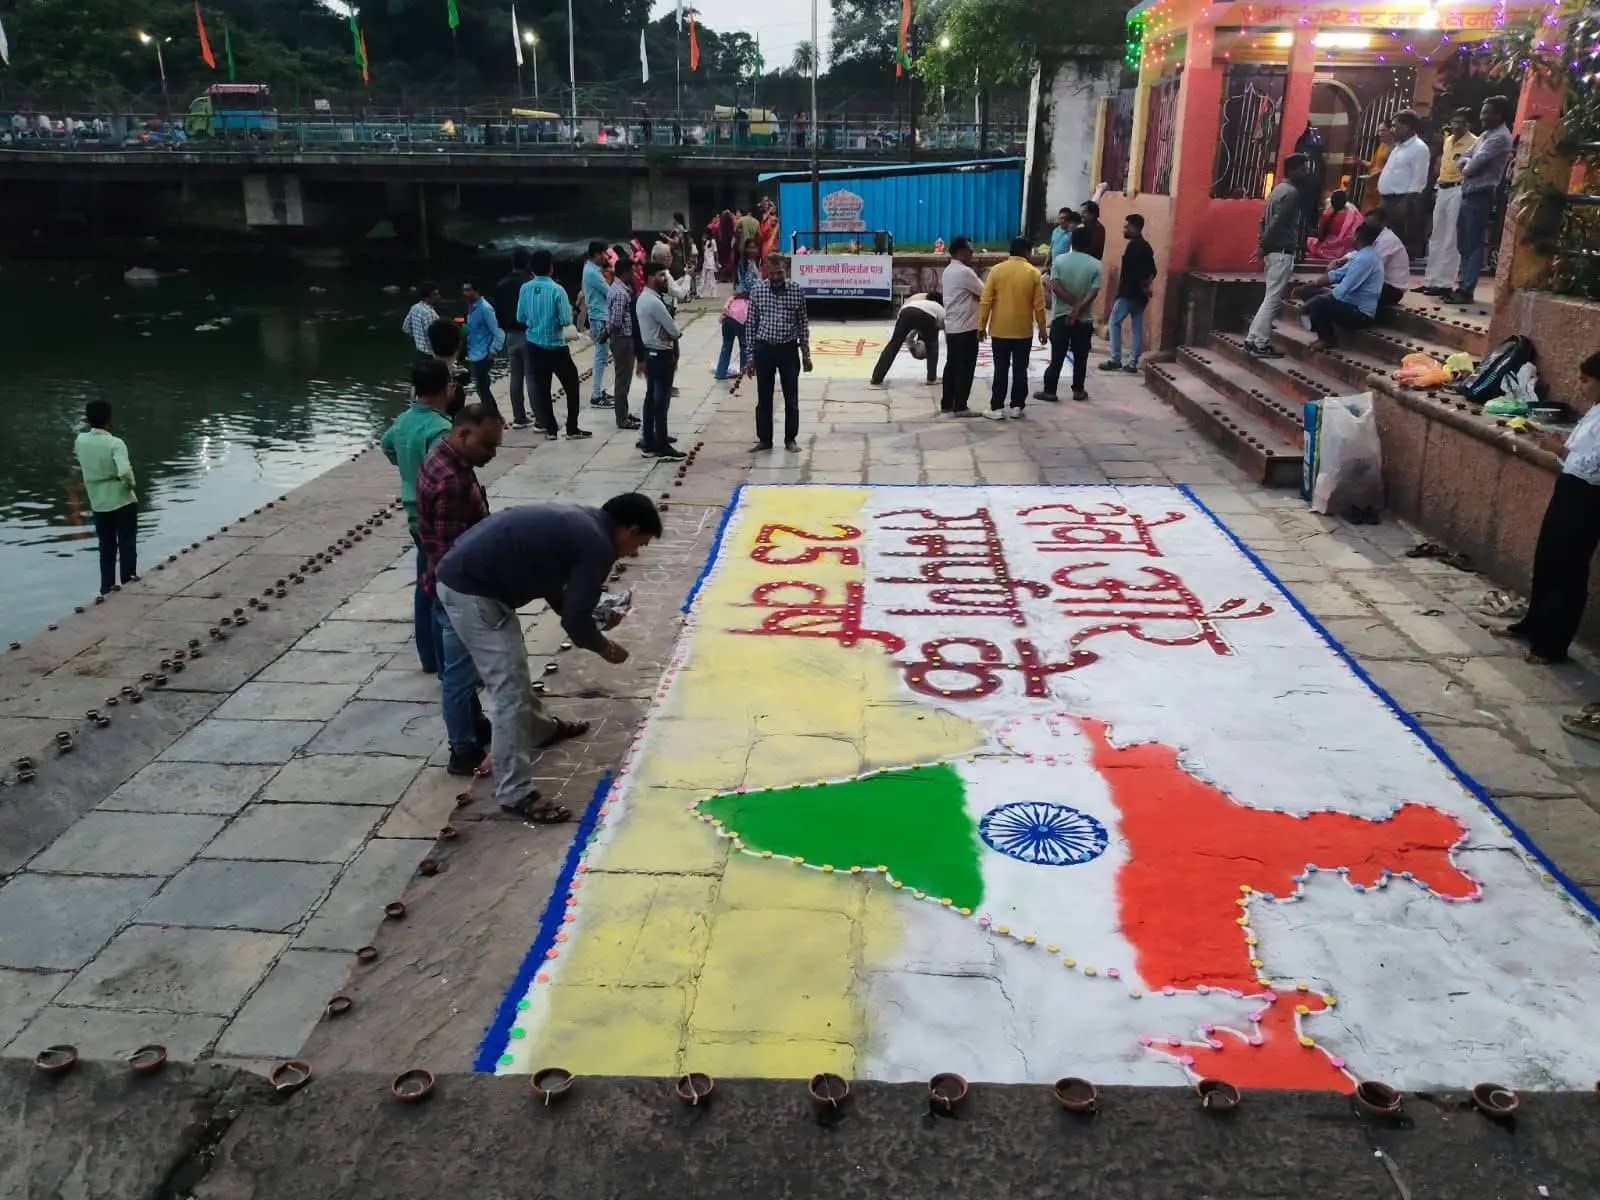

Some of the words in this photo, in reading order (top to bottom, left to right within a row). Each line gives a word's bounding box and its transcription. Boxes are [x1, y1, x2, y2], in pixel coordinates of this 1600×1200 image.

[750, 522, 863, 566] 25
[1015, 502, 1186, 558] सेवा
[873, 506, 1053, 627] समर्पण
[722, 579, 907, 655] वर्ष
[1051, 560, 1275, 656] और
[894, 636, 1101, 698] के
